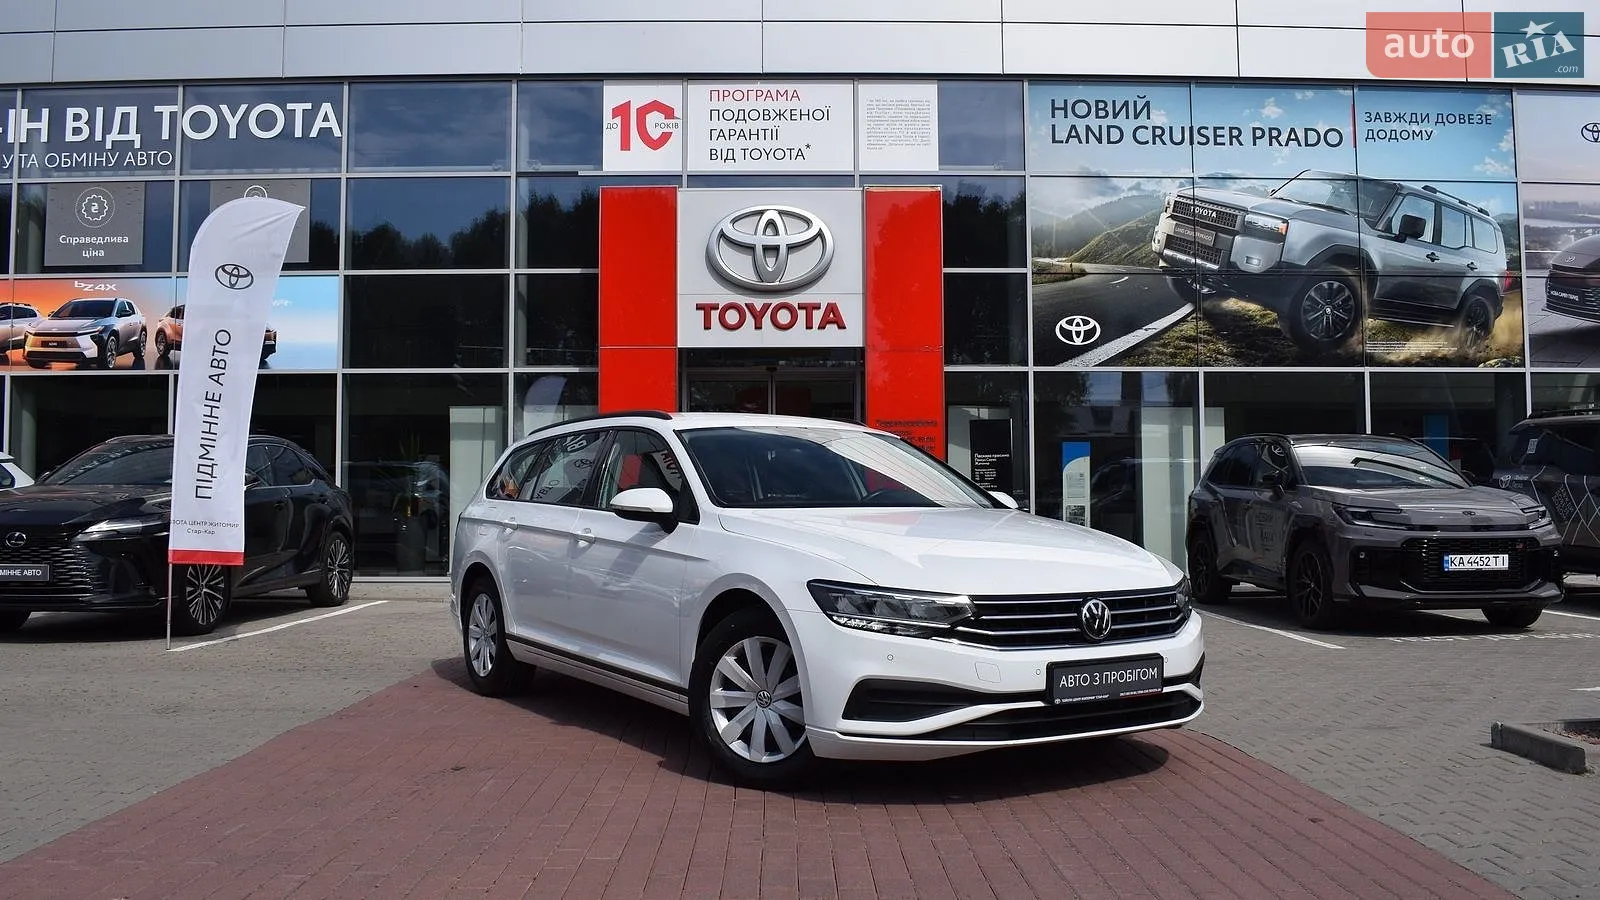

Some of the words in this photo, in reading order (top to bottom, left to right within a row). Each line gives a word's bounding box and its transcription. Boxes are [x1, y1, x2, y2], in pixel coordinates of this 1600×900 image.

[709, 89, 801, 102] ПРОГРАМА
[709, 105, 832, 124] ПОДОВЖЕНОЇ
[1051, 95, 1151, 121] НОВИЙ
[65, 106, 141, 150] ВІД
[154, 103, 342, 141] TOYOTA
[606, 122, 619, 130] ДО
[1364, 111, 1430, 125] ЗАВЖДИ
[1435, 112, 1492, 126] ДОВЕЗЕ
[709, 125, 780, 141] ГАРАНТІЇ
[1051, 124, 1124, 145] LAND
[1132, 125, 1243, 147] CRUISER
[1252, 126, 1344, 148] PRADO
[1365, 128, 1434, 142] ДОДОМУ
[19, 153, 39, 168] ТА
[45, 151, 119, 168] ОБМІНУ
[124, 150, 173, 167] АВТО
[709, 148, 736, 163] ВІД
[1190, 206, 1217, 218] TOYOTA
[59, 235, 129, 245] Справедлива
[82, 248, 105, 258] ціна
[695, 302, 847, 331] TOYOTA
[208, 329, 231, 386] АВТО
[195, 391, 222, 500] ПІДМІННЕ
[1449, 556, 1465, 567] KA
[1467, 556, 1491, 567] 4452
[1059, 673, 1090, 688] АВТО
[1092, 672, 1100, 685] З
[1103, 667, 1158, 684] ПРОБІГОМ
